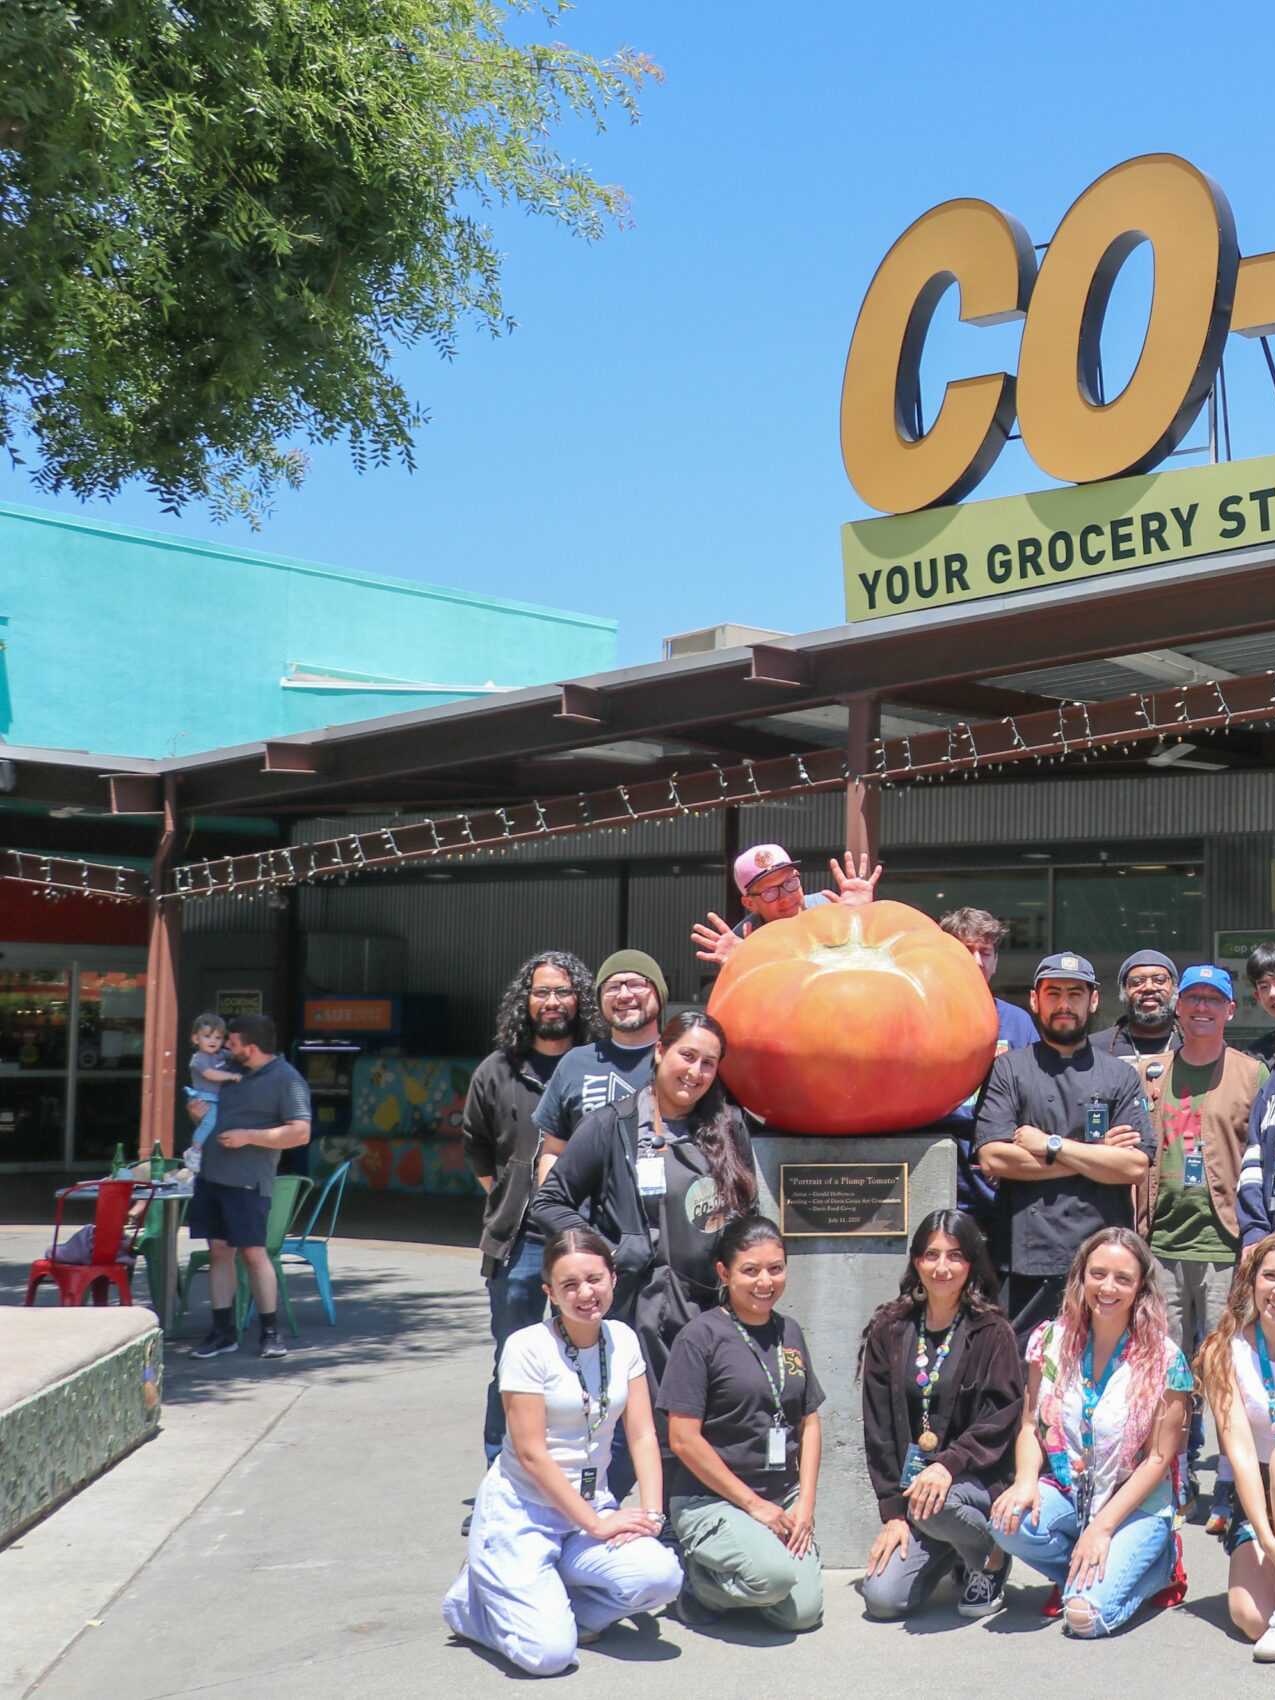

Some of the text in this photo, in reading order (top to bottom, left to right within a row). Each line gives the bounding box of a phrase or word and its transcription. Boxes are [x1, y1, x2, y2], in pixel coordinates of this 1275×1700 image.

[858, 552, 970, 610] YOUR
[987, 503, 1200, 584] GROCERY
[841, 1177, 865, 1186] Plump
